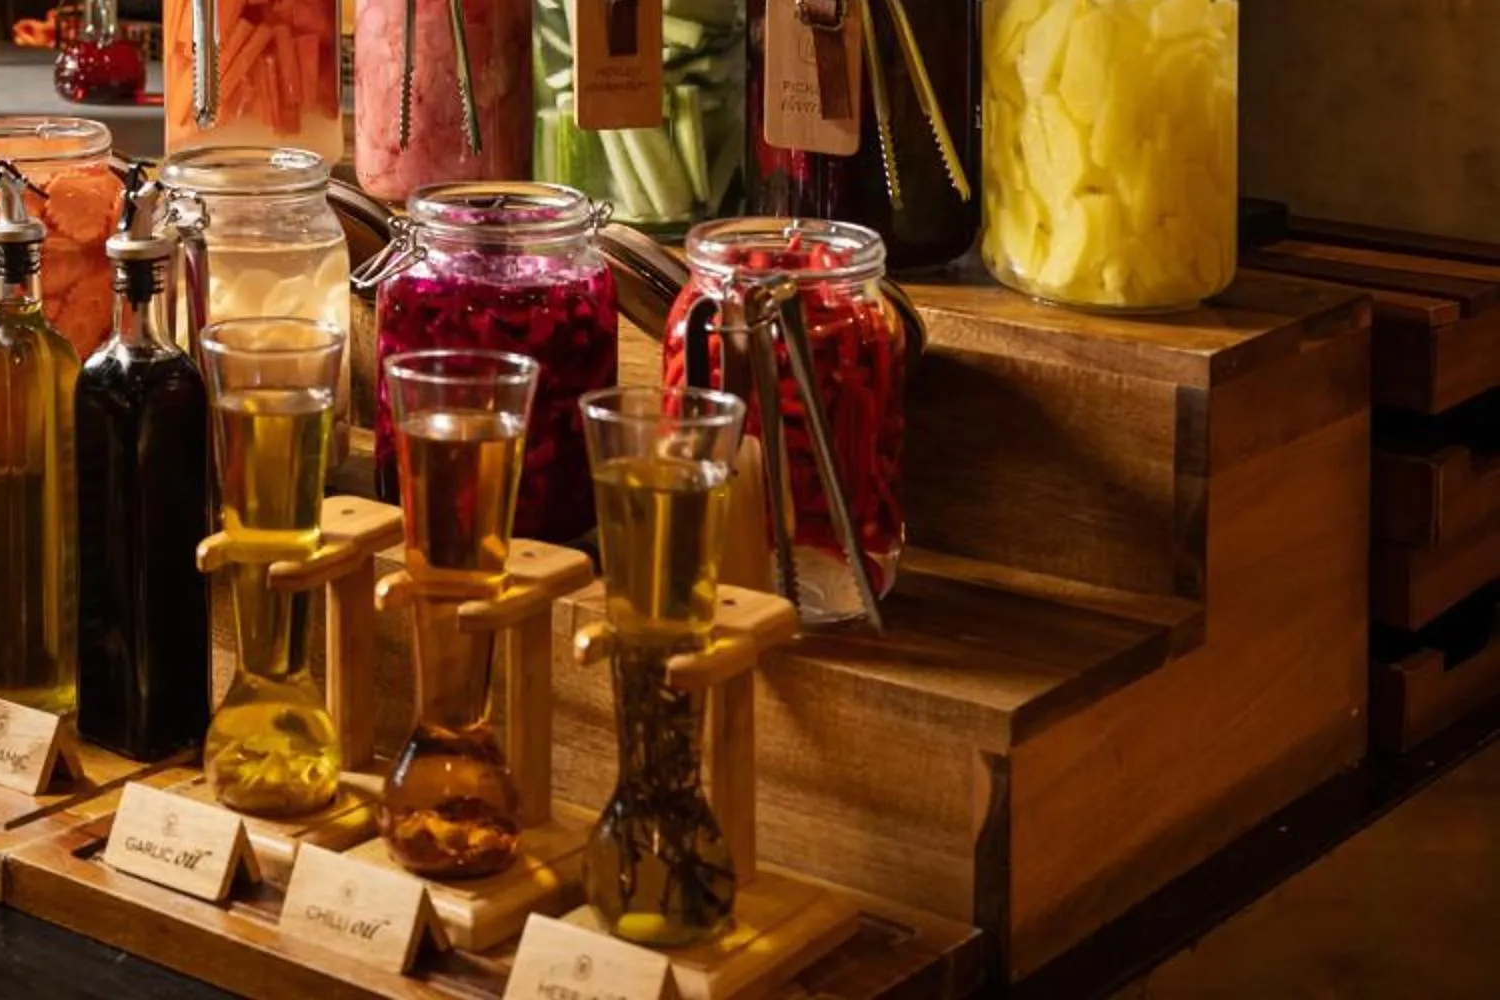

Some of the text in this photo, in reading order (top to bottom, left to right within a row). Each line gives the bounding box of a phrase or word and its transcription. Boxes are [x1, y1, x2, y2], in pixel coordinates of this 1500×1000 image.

[125, 836, 213, 870] GARLIC oil
[305, 904, 392, 940] CHILLI oil
